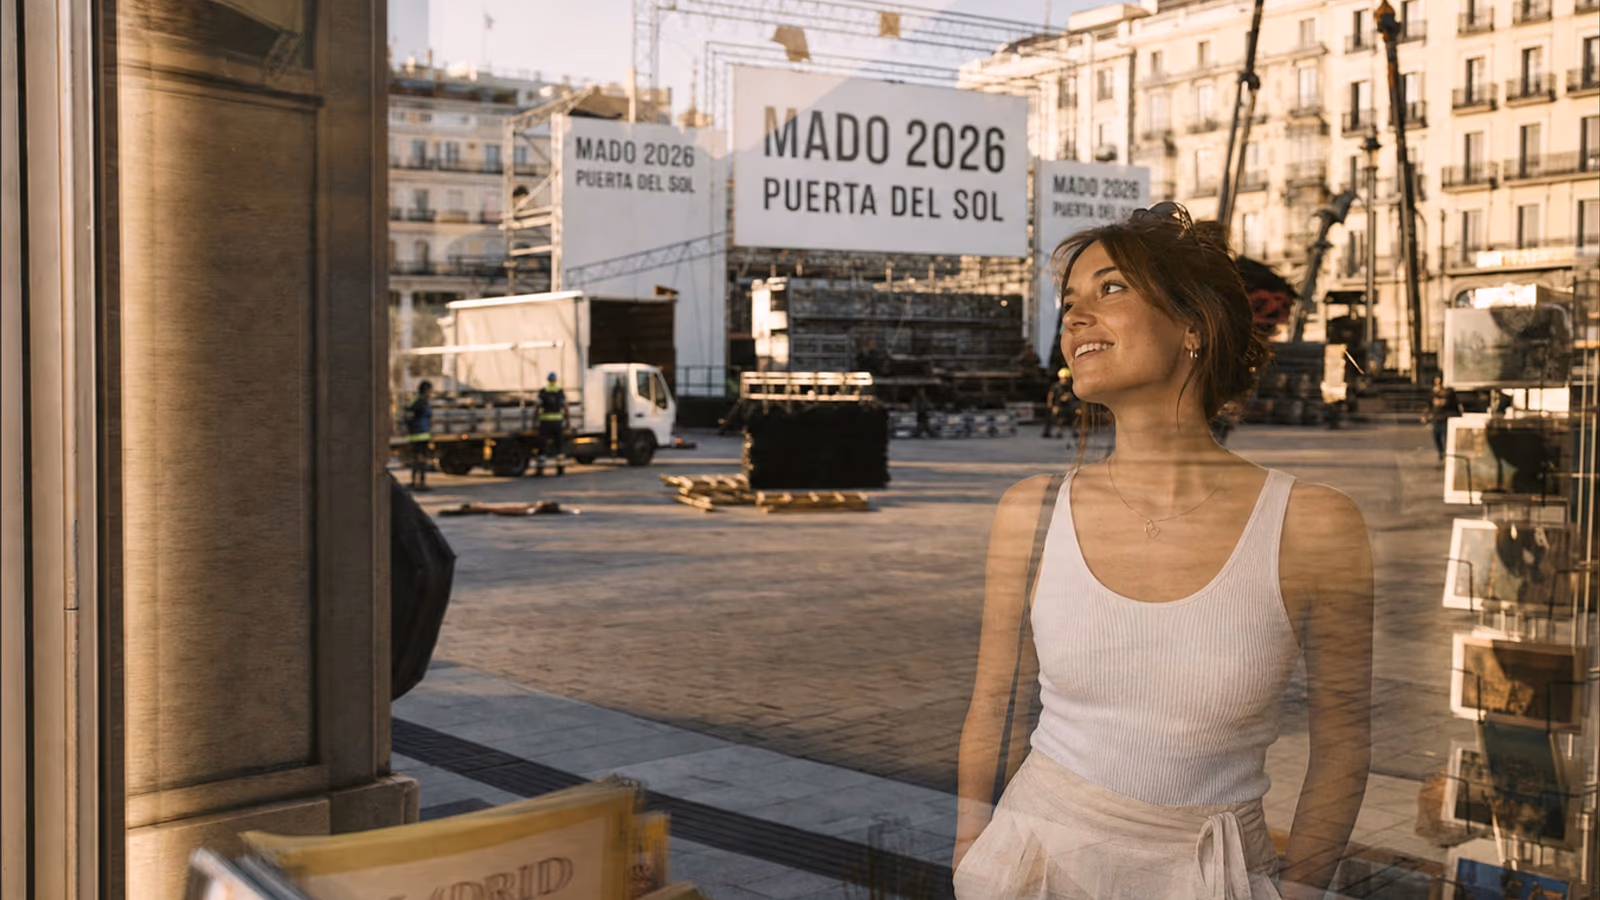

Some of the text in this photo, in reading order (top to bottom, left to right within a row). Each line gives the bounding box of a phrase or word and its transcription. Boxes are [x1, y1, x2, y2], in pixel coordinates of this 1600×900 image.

[576, 137, 695, 168] MADO 2026
[763, 105, 1006, 174] MADO 2026
[576, 169, 697, 194] PUERTA DEL SOL
[1053, 175, 1139, 199] MADO 2026
[763, 177, 1005, 222] PUERTA DEL SOL
[1053, 201, 1094, 217] PUERTA
[1098, 203, 1117, 219] DEL
